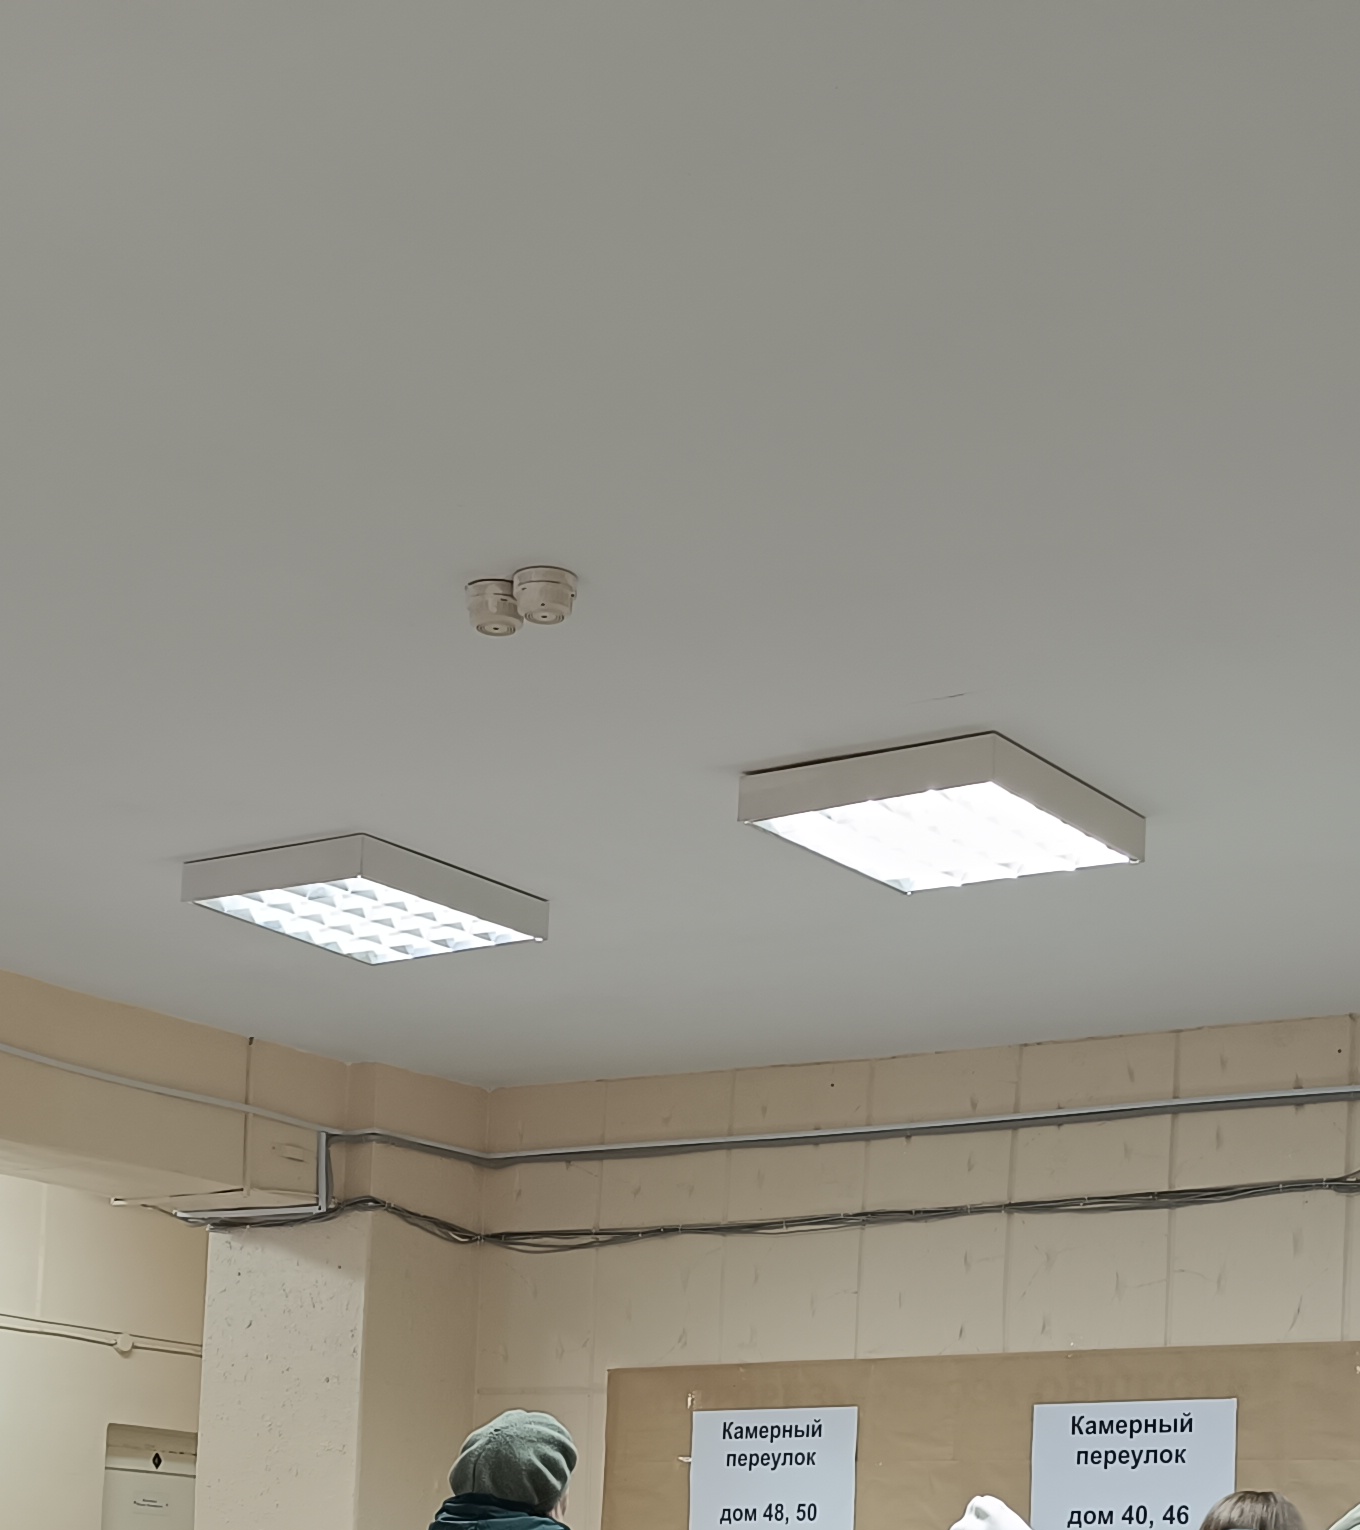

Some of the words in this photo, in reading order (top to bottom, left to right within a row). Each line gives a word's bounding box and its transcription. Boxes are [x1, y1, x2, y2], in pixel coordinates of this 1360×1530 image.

[722, 1419, 822, 1443] Камерный
[1071, 1412, 1193, 1438] Камерный
[726, 1451, 816, 1471] переулок
[1076, 1448, 1187, 1469] переулок
[719, 1508, 757, 1524] дом
[762, 1503, 789, 1525] 48,
[796, 1503, 817, 1522] 50
[1067, 1509, 1114, 1528] дом
[1121, 1505, 1154, 1529] 40,
[1162, 1505, 1189, 1525] 46
